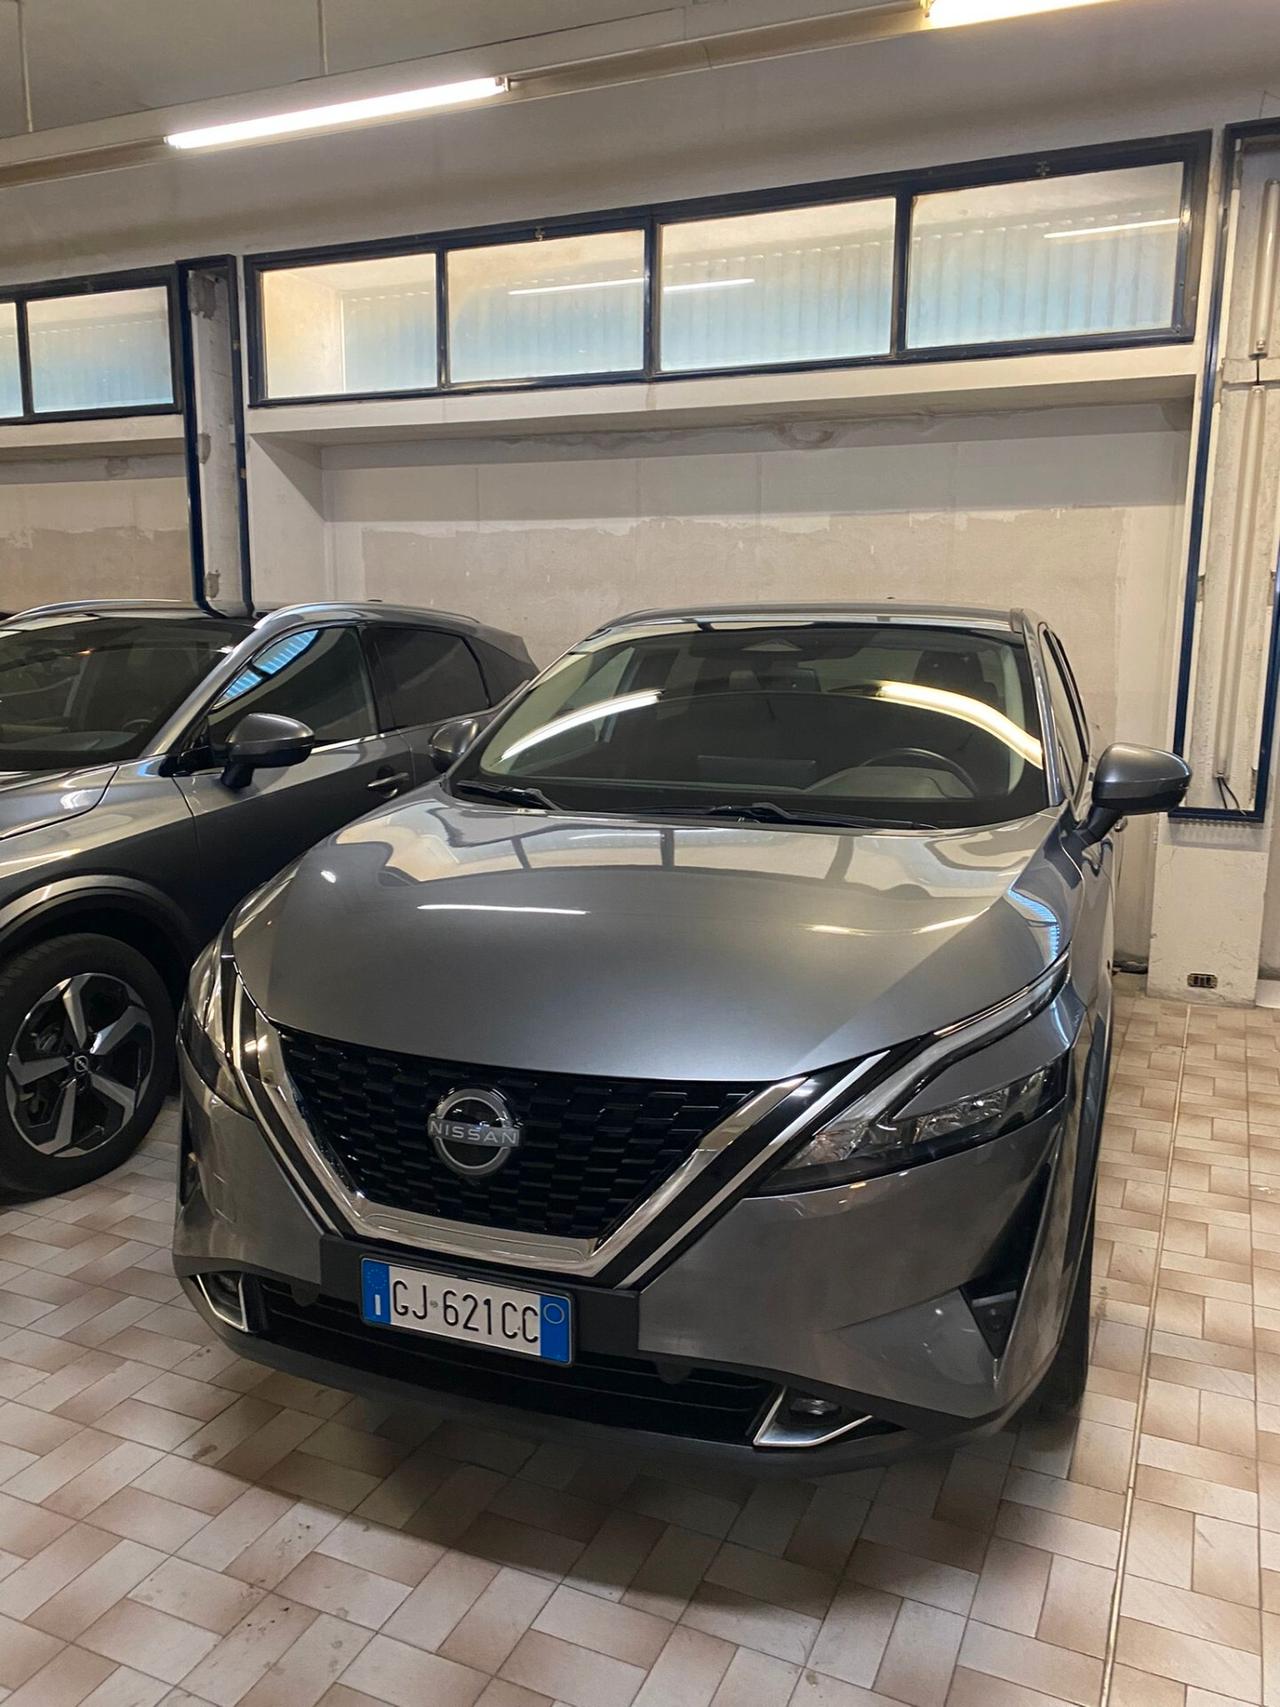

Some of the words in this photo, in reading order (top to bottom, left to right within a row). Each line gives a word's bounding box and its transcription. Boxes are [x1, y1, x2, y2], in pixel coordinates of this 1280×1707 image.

[430, 1120, 517, 1145] NISSAN
[393, 1280, 428, 1320] GJ
[442, 1289, 539, 1343] 621CC
